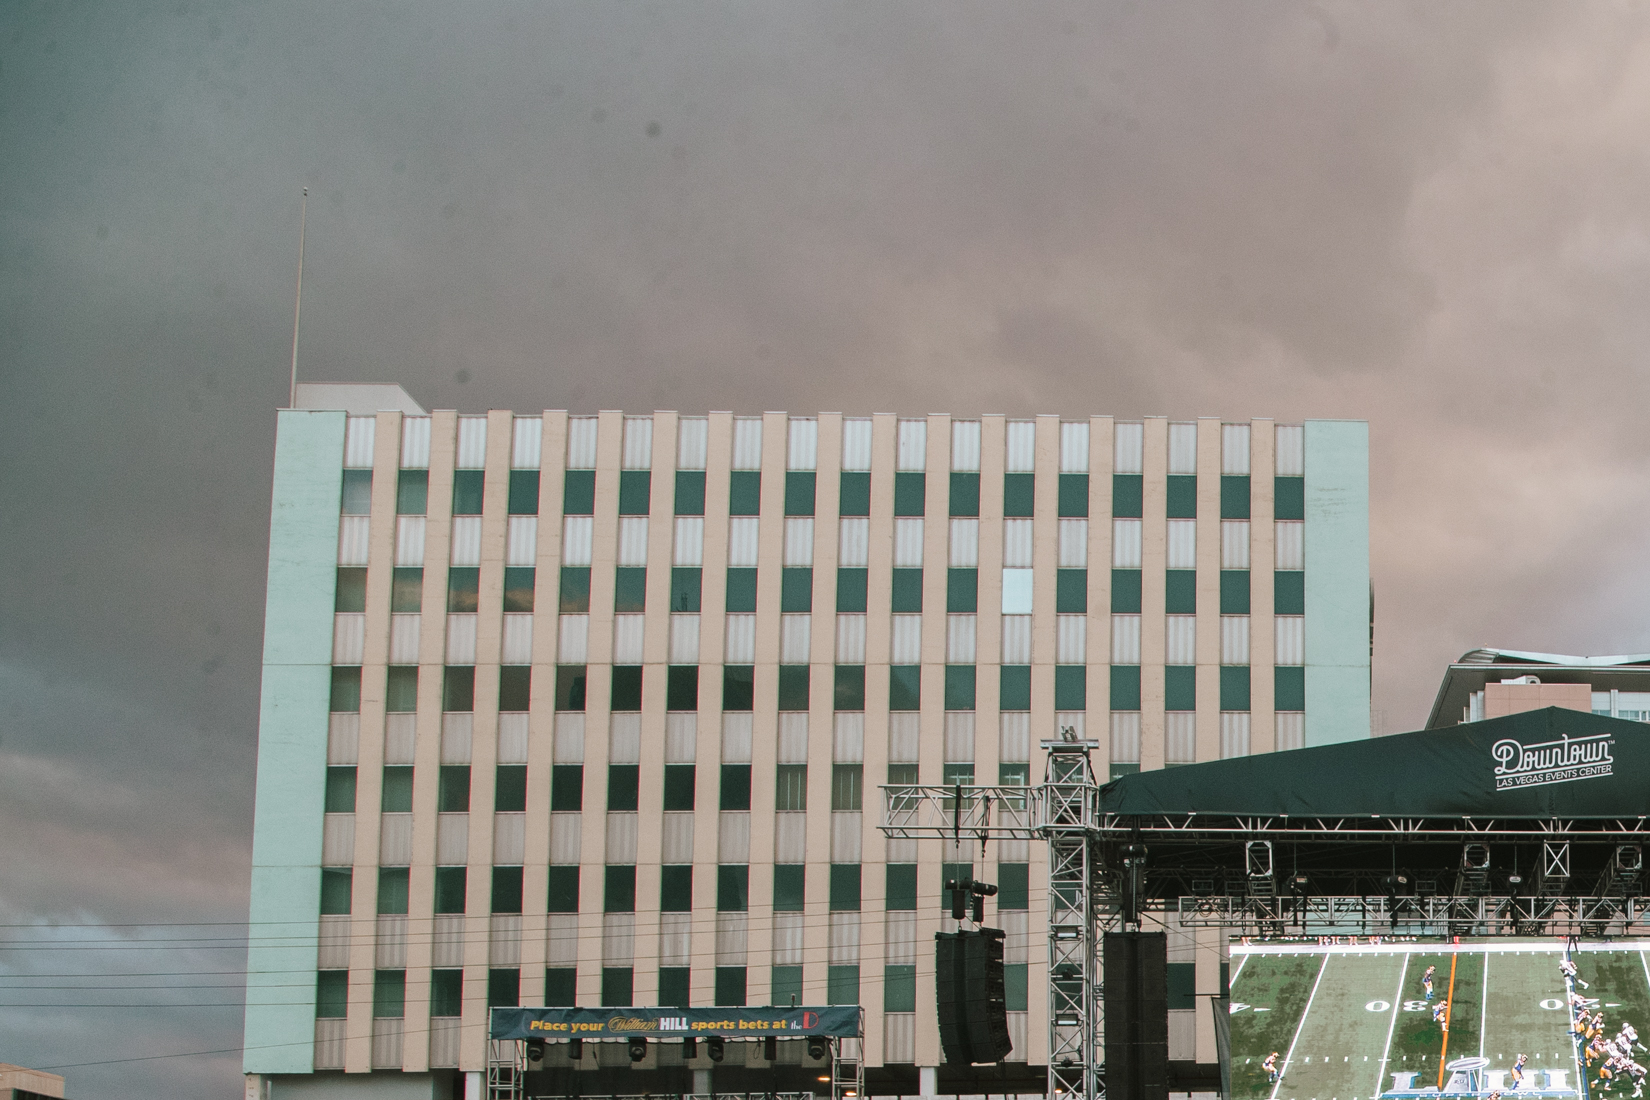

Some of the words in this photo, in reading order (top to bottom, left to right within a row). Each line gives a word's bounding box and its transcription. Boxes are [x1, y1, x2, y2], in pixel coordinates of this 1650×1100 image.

[1492, 734, 1613, 774] Downtown
[1497, 779, 1513, 787] LAS
[1515, 774, 1543, 785] VEGAS
[1545, 769, 1577, 781] EVENTS
[1579, 764, 1612, 776] CENTER
[530, 1020, 568, 1031] Place
[570, 1022, 605, 1033] your
[608, 1016, 659, 1033] William
[659, 1018, 689, 1031] HILL
[691, 1019, 735, 1032] sports
[739, 1019, 769, 1030] bets
[772, 1019, 786, 1029] at
[803, 1012, 819, 1029] D
